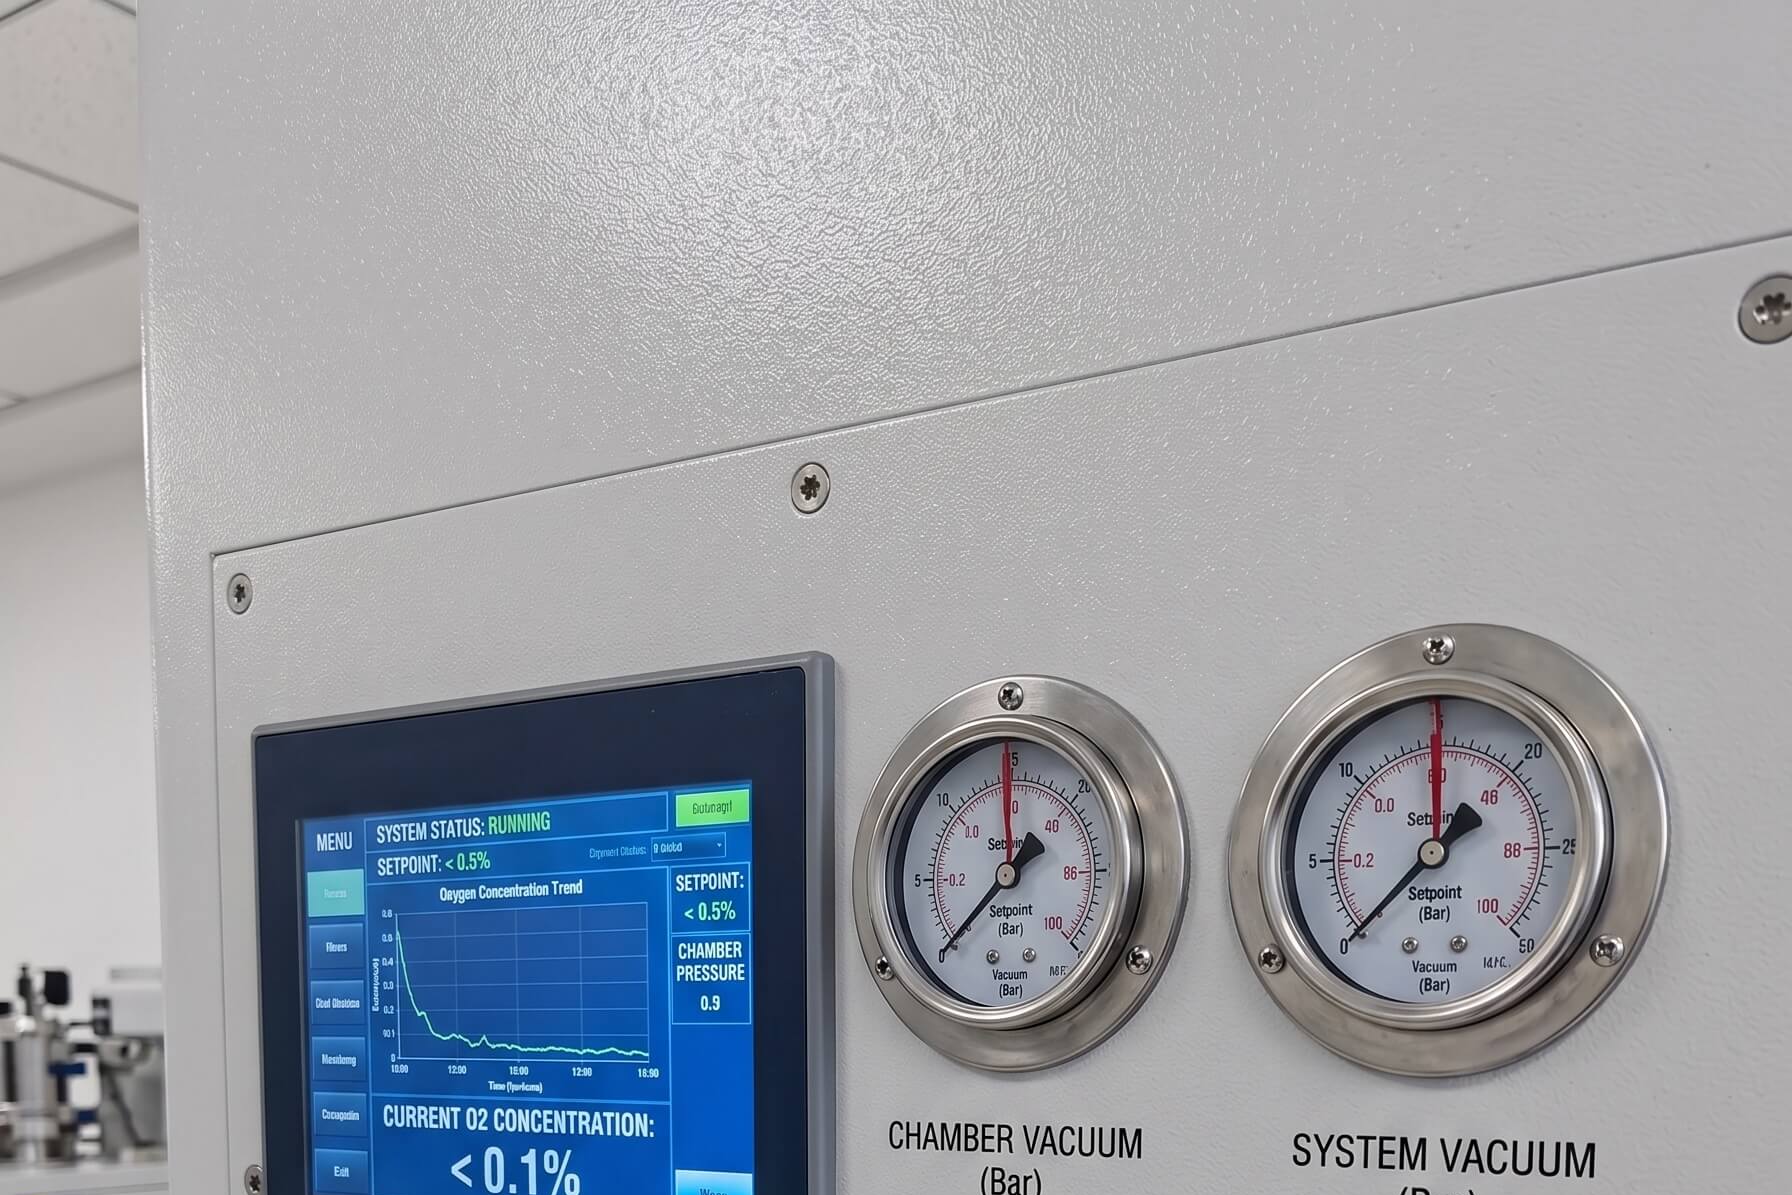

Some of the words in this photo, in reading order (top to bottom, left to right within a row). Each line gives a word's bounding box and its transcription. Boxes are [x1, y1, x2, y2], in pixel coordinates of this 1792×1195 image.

[1524, 743, 1542, 759] 20
[1338, 762, 1353, 778] 10
[937, 793, 949, 806] 10
[1375, 798, 1394, 813] 0.0
[377, 822, 427, 844] SYSTEM
[430, 817, 485, 839] STATUS:
[488, 811, 551, 835] RUNNING
[316, 831, 352, 852] MENU
[377, 854, 441, 877] SETPOINT:
[445, 858, 454, 870] <
[457, 851, 491, 871] 0.5%
[1308, 854, 1317, 869] 5
[1353, 853, 1374, 868] 0.2
[914, 874, 921, 887] 5
[949, 873, 965, 887] 0.2
[1063, 866, 1077, 880] 86
[479, 882, 549, 899] Concentration
[551, 879, 583, 895] Trend
[675, 871, 745, 892] SETPOINT:
[1408, 886, 1462, 902] Setpoint
[684, 907, 694, 920] <
[698, 901, 736, 921] 0.5%
[989, 904, 1033, 918] Setpoint
[1419, 906, 1450, 923] (Bar)
[1477, 899, 1498, 914] 100
[998, 922, 1023, 937] (Bar)
[1044, 916, 1062, 930] 100
[678, 941, 742, 959] CHAMBER
[1340, 939, 1348, 955] 0
[1519, 938, 1535, 954] 50
[938, 949, 945, 963] 0
[676, 964, 745, 982] PRESSURE
[1412, 960, 1457, 973] Vacuum
[992, 969, 1028, 981] Vacuum
[999, 984, 1023, 998] (Bar)
[1419, 978, 1450, 994] (Bar)
[700, 995, 720, 1011] 0.9
[383, 1104, 461, 1130] CURRENT
[493, 1108, 655, 1138] CONCENTRATION:
[889, 1120, 1014, 1154] CHAMBER
[1022, 1124, 1143, 1160] VACUUM
[1292, 1132, 1427, 1171] SYSTEM
[1440, 1138, 1596, 1178] VACUUM
[451, 1153, 473, 1188] <
